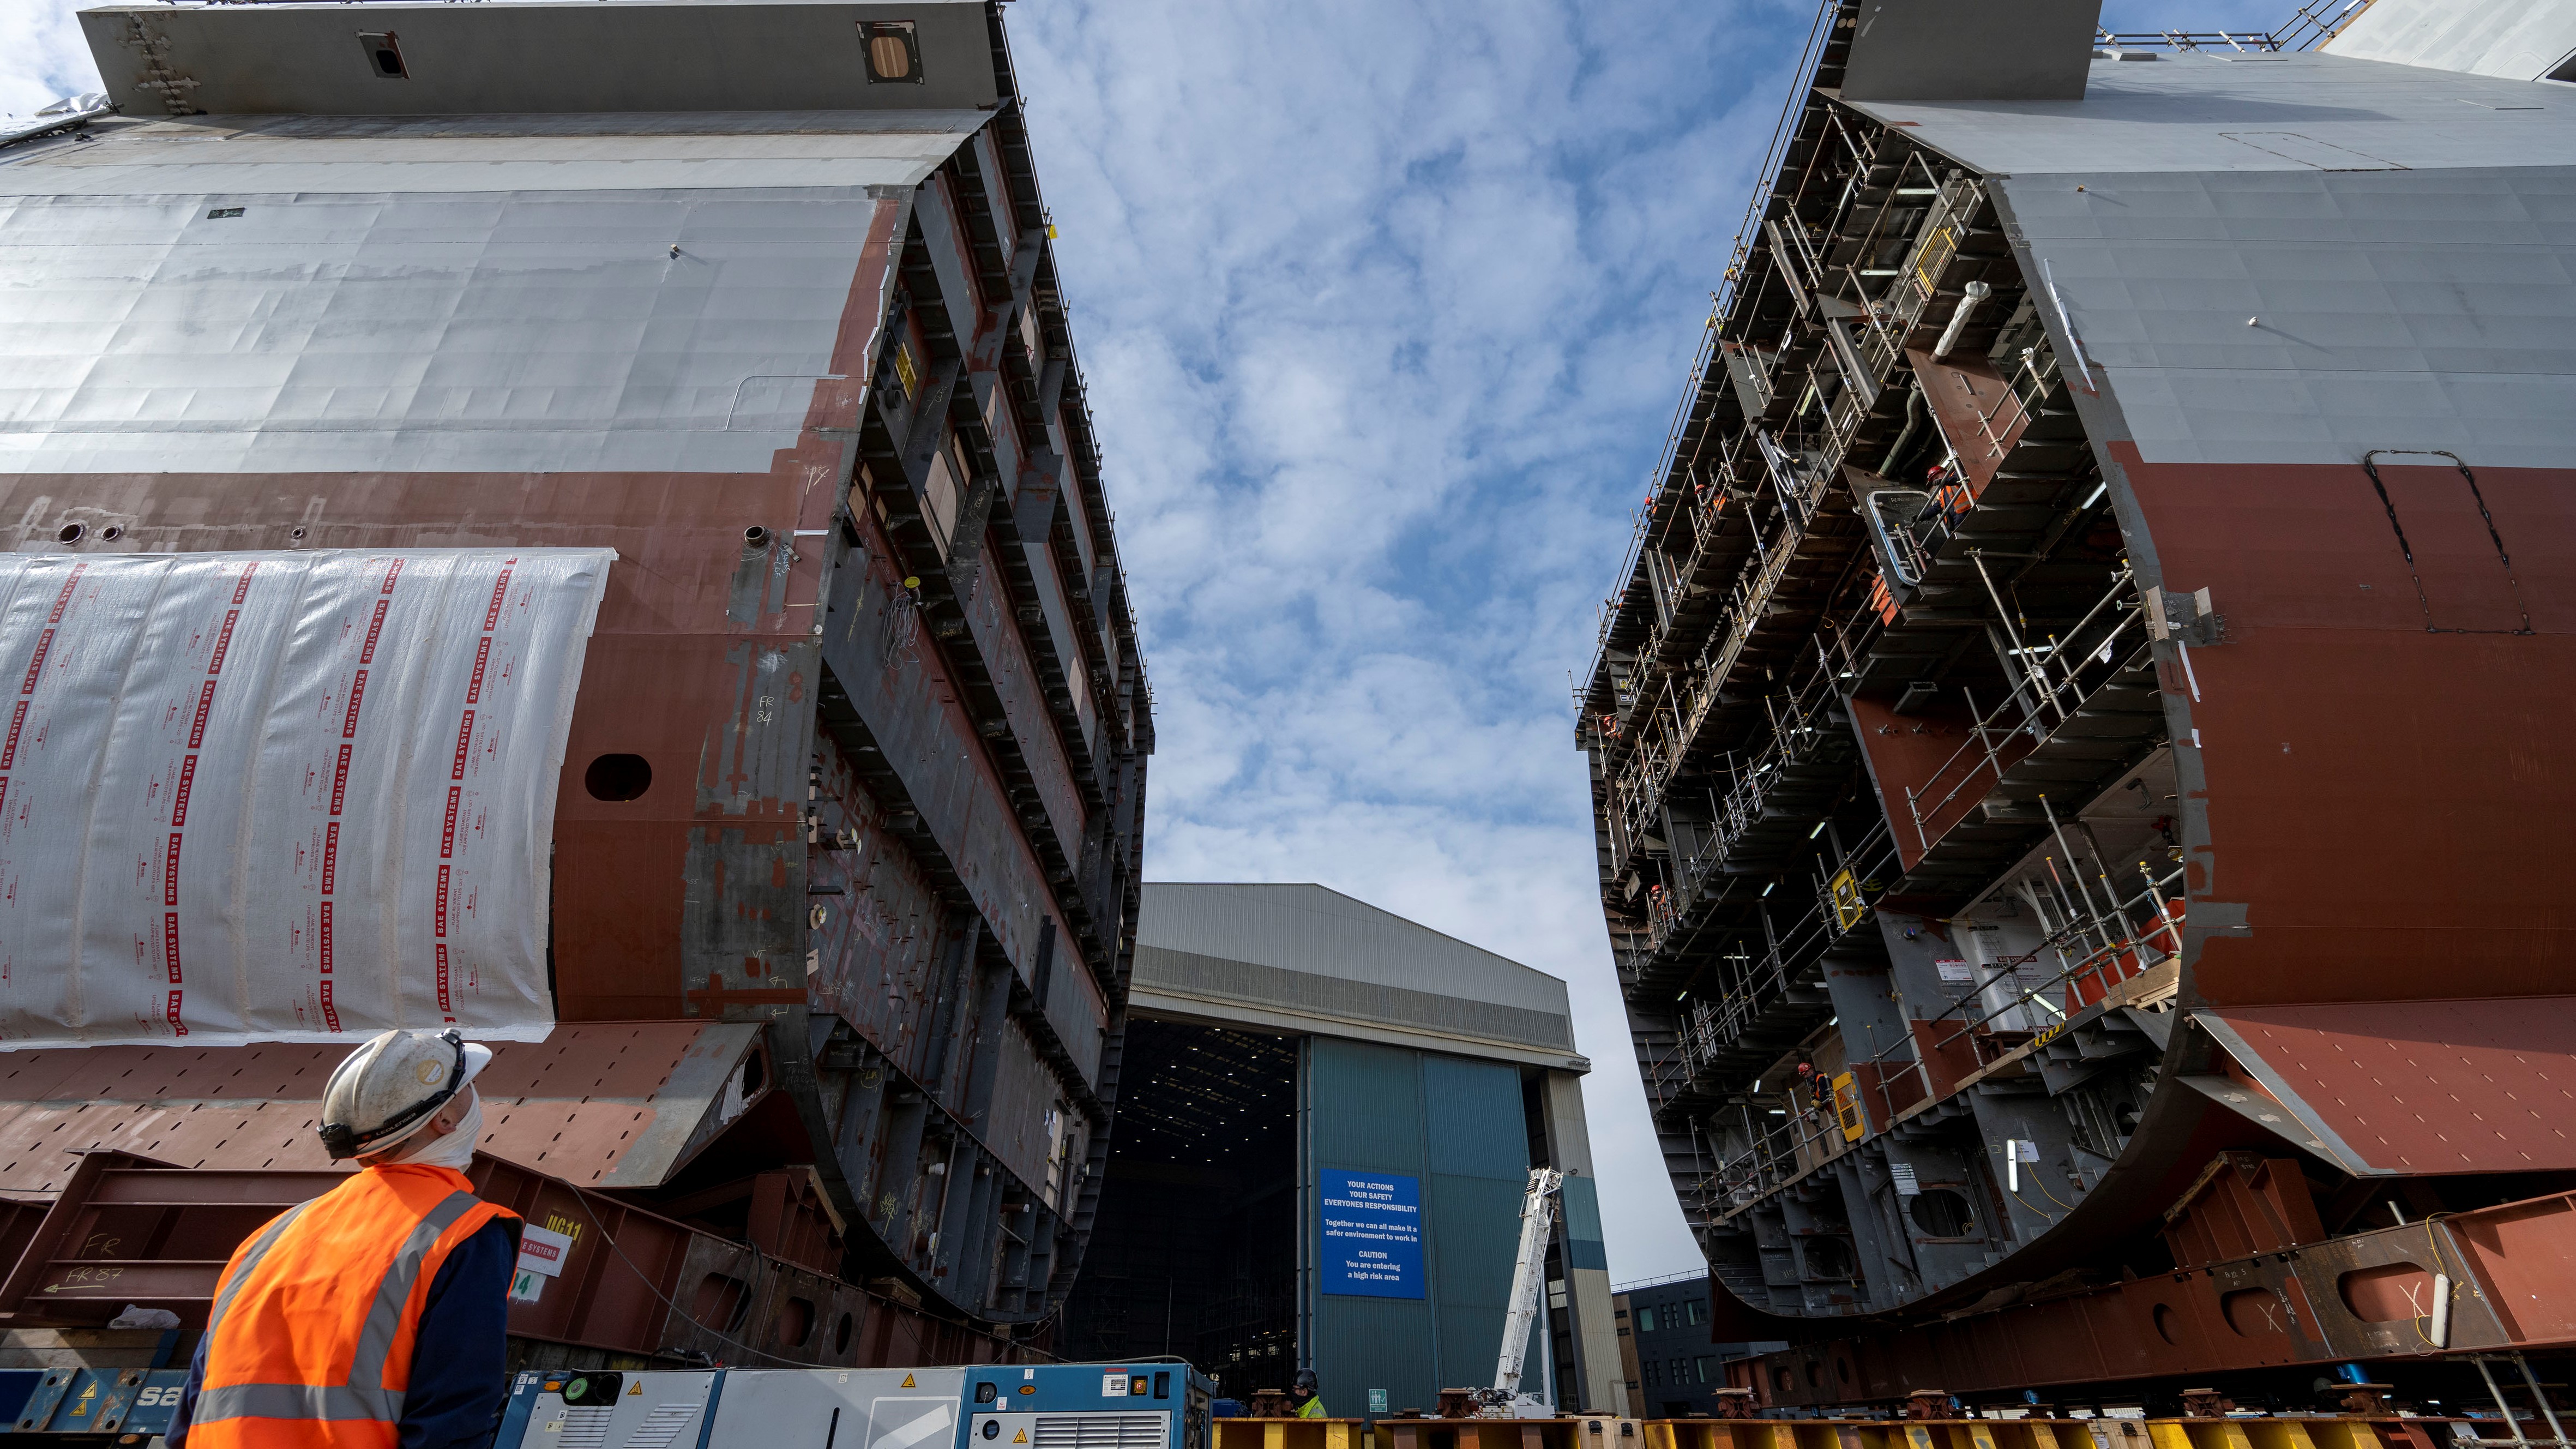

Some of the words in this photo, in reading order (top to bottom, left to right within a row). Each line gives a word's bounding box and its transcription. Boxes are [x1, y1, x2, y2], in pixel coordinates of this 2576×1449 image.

[486, 612, 496, 627] BAE
[492, 572, 508, 608] SYSTEMS
[52, 604, 64, 620] BAE
[376, 603, 386, 618] BAE
[225, 614, 235, 629] BAE
[364, 622, 379, 660] SYSTEMS
[25, 674, 35, 691] BAE
[33, 633, 51, 671] SYSTEMS
[212, 633, 229, 671] SYSTEMS
[470, 683, 478, 700] BAE
[474, 641, 488, 680] SYSTEMS
[203, 684, 213, 700] BAE
[356, 674, 365, 690] BAE
[760, 696, 774, 708] FR
[347, 694, 360, 733] SYSTEMS
[756, 711, 772, 727] 84
[3, 748, 13, 766] BAE
[9, 704, 26, 745] SYSTEMS
[192, 705, 207, 744] SYSTEMS
[459, 714, 471, 754] SYSTEMS
[184, 760, 193, 776] BAE
[334, 769, 345, 811] SYSTEMS
[176, 780, 189, 822] SYSTEMS
[447, 791, 457, 832] SYSTEMS
[325, 848, 334, 890] SYSTEMS
[438, 869, 447, 911] SYSTEMS
[169, 939, 178, 979] SYSTEMS
[170, 995, 179, 1013] BAE
[1325, 1199, 1363, 1208] EVERYONES
[1365, 1203, 1417, 1212] RESPONSIBILITY
[1326, 1219, 1354, 1228] Together
[80, 1233, 121, 1258] FR
[1345, 1231, 1385, 1240] environment
[528, 1243, 557, 1258] SYSTEMS
[65, 1266, 93, 1283] FR
[95, 1267, 124, 1281] 87
[1353, 1271, 1368, 1280] high
[1373, 1263, 1400, 1271] entering
